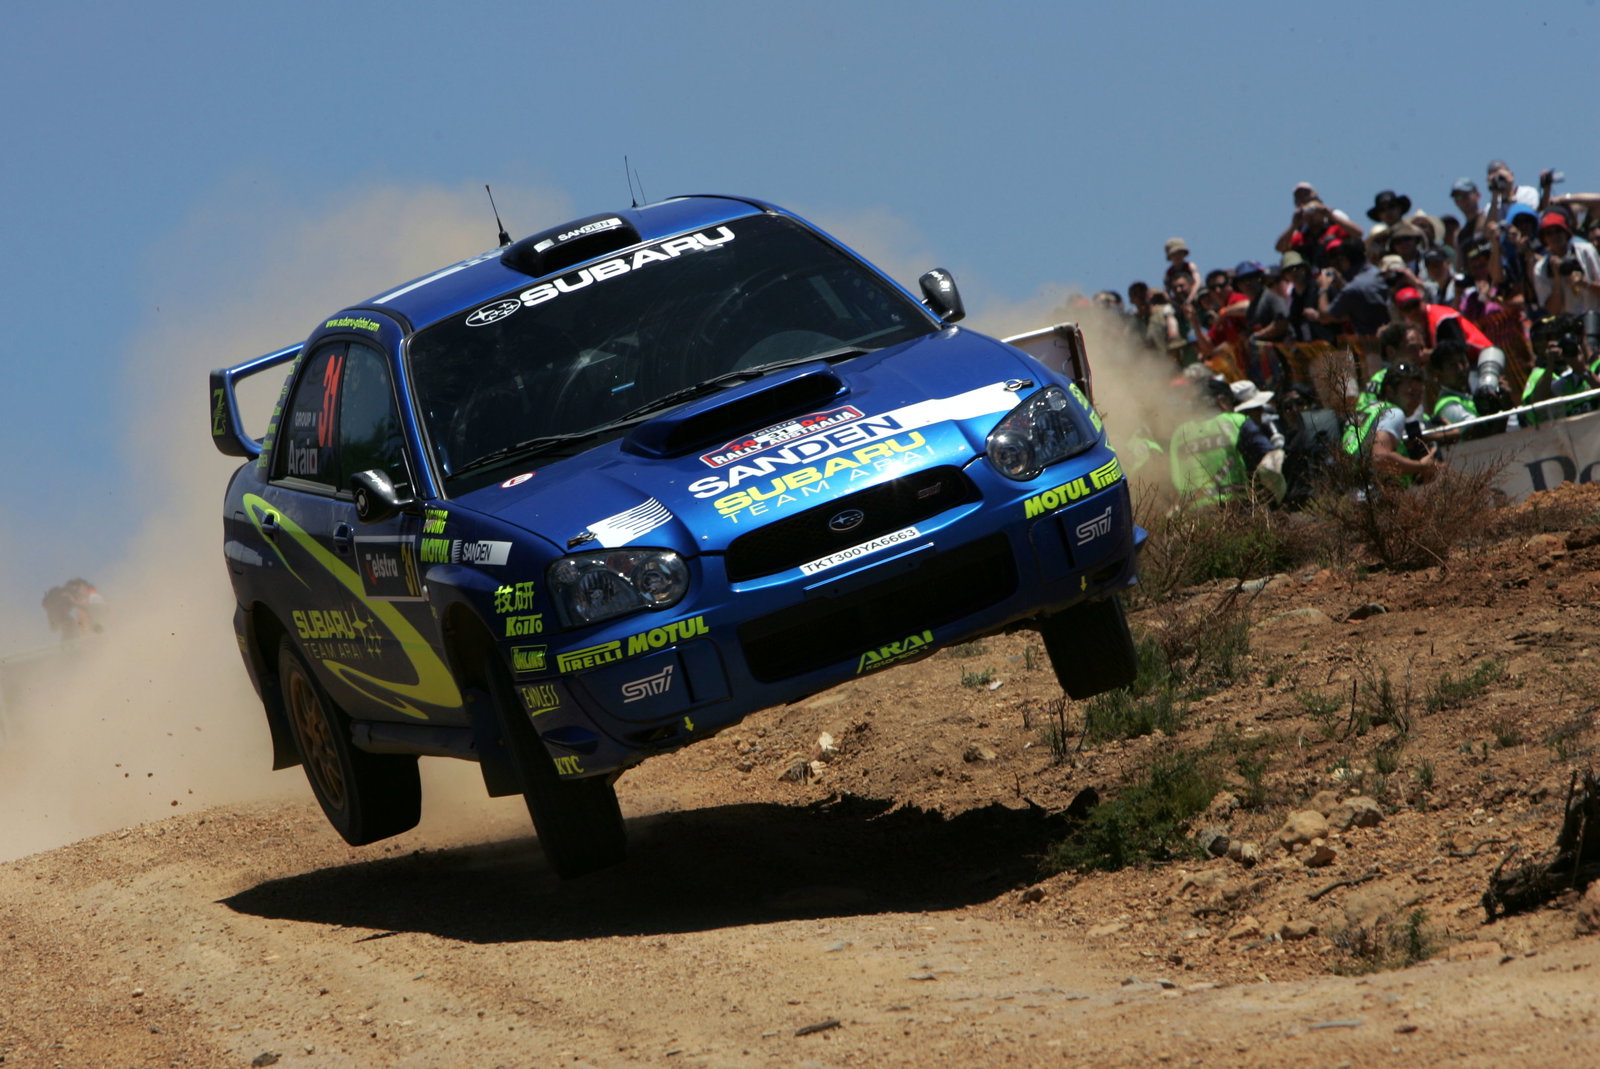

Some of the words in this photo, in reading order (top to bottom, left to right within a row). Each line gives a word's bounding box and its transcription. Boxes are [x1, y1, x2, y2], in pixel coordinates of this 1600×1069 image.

[557, 220, 610, 242] SANDEN
[519, 226, 735, 307] SUBARU
[318, 354, 343, 448] 31
[688, 415, 903, 499] SANDEN
[711, 440, 762, 466] RALLY
[769, 410, 857, 446] AUSTRALIA
[714, 431, 926, 515] SUBARU
[723, 480, 831, 524] TEAM
[850, 445, 935, 481] ARAI
[1025, 477, 1090, 519] MOTUL
[420, 538, 450, 563] MOTUL
[462, 542, 493, 561] SANDEN
[803, 529, 916, 573] TKT300YA6663
[494, 581, 535, 613] 技研
[292, 610, 356, 640] SUBARU
[556, 640, 623, 673] PIRELLI
[627, 616, 709, 656] MOTUL
[303, 642, 336, 659] TEAM
[856, 629, 934, 674] ARAI
[521, 684, 560, 708] ENDLESS
[553, 755, 585, 775] KTC
